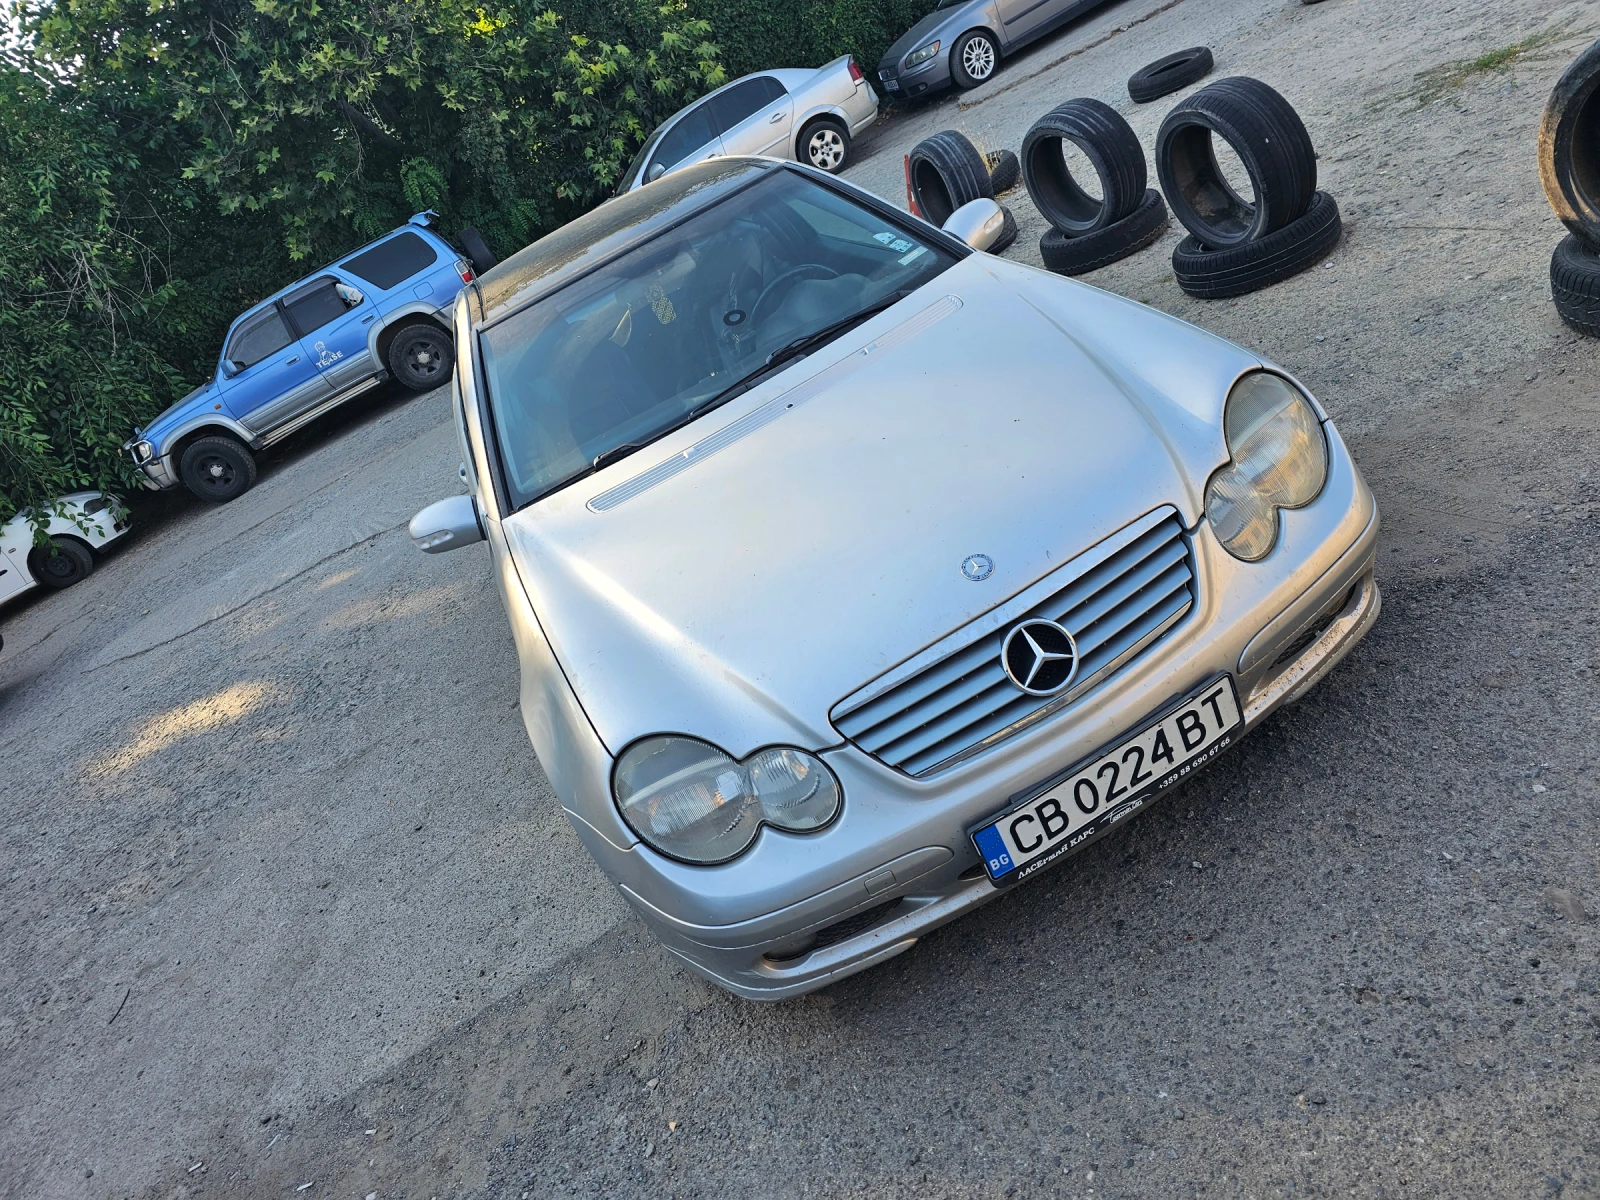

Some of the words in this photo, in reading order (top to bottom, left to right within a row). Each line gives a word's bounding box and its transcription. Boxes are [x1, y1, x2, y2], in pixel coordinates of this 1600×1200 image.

[315, 351, 343, 368] TEASE
[1009, 798, 1069, 854] CB
[1074, 727, 1174, 814] 0224
[1175, 687, 1225, 753] BT
[1159, 773, 1179, 789] +359
[1180, 765, 1191, 776] 88
[1192, 754, 1208, 768] 690
[1209, 744, 1219, 756] 67
[1220, 736, 1231, 748] 66
[990, 853, 1010, 871] BG
